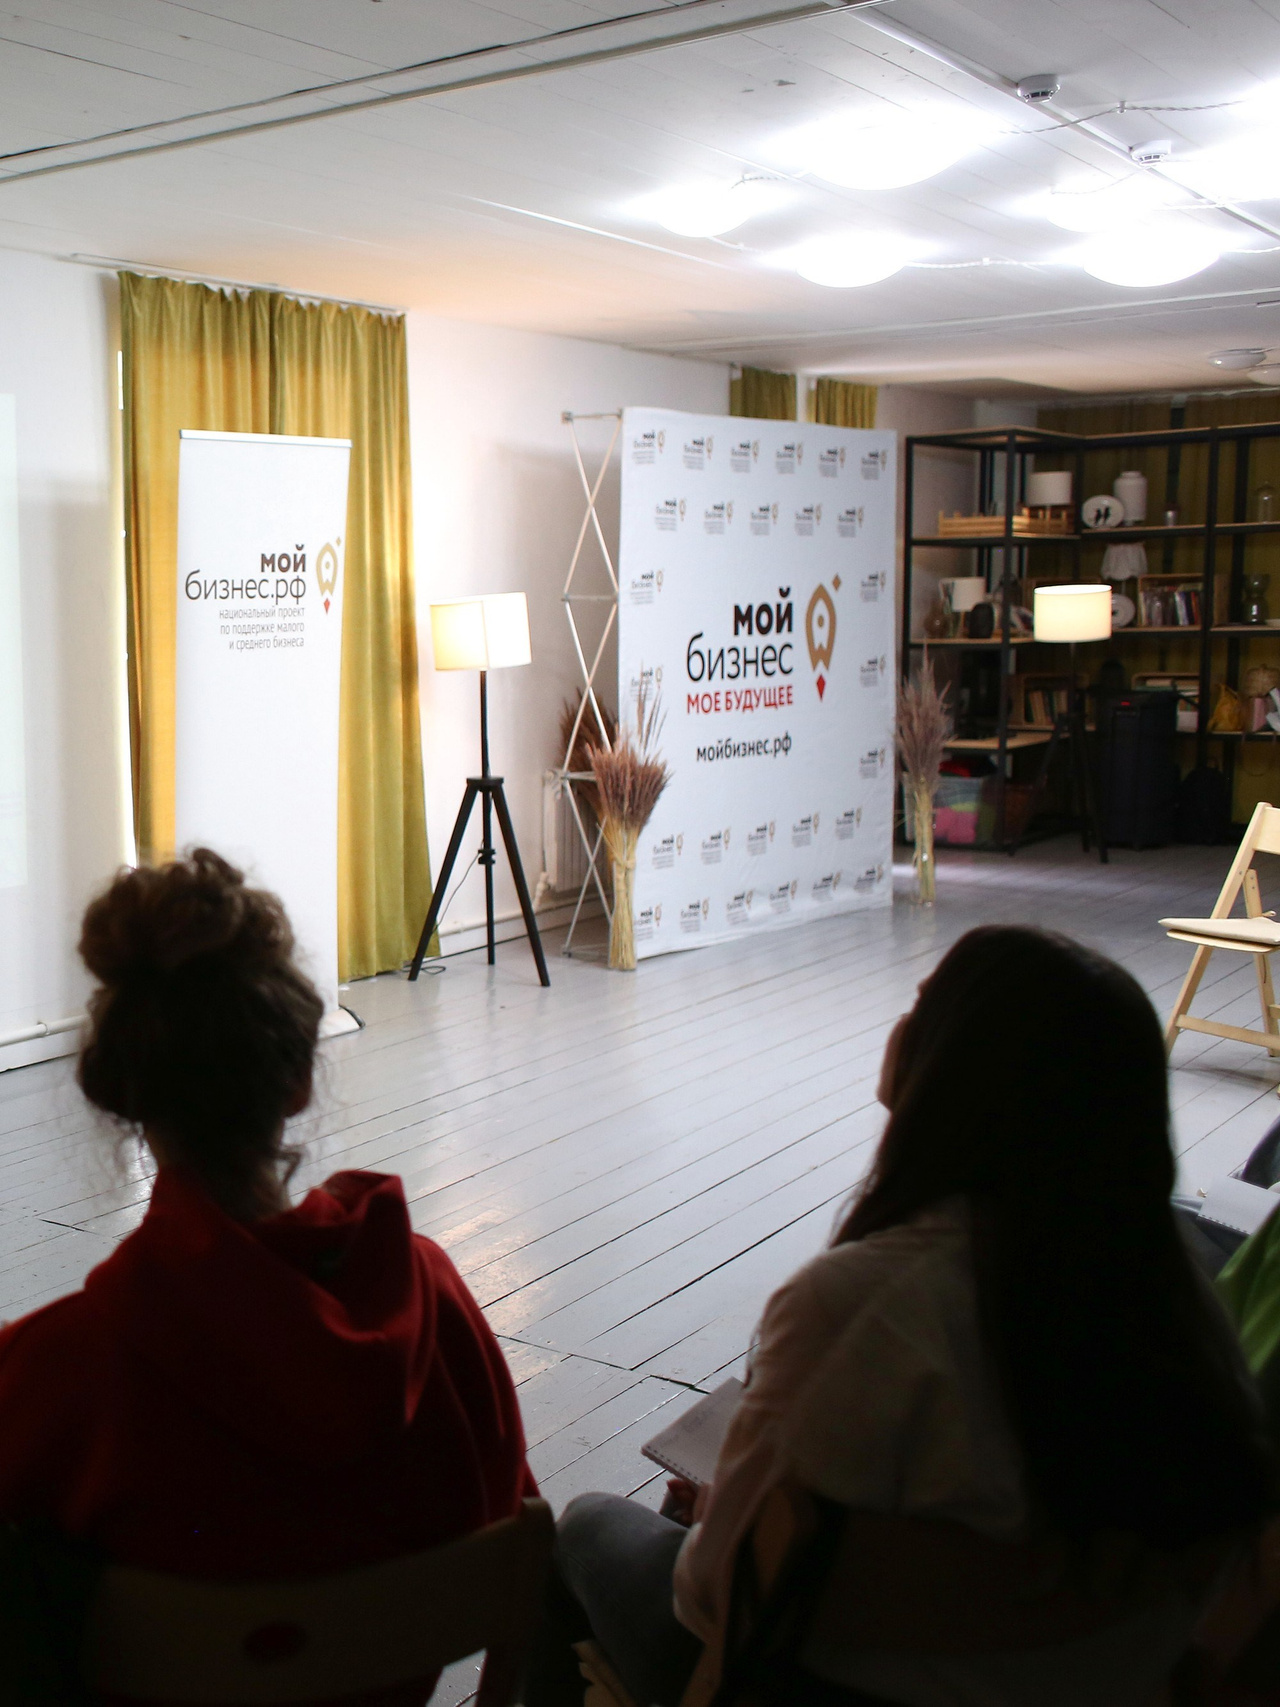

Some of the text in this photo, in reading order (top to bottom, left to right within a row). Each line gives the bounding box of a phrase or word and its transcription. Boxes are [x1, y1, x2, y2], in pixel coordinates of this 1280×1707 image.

[260, 544, 306, 573] мой
[185, 569, 306, 605] бизнес.рф
[219, 606, 305, 620] национальный проект
[734, 587, 793, 636] мой
[220, 623, 304, 637] по поддержке малого
[229, 635, 304, 652] и среднего бизнеса
[687, 632, 793, 683] бизнес
[687, 684, 793, 714] МОЕ БУДУЩЕЕ
[696, 731, 792, 763] мойбизнес.рф
